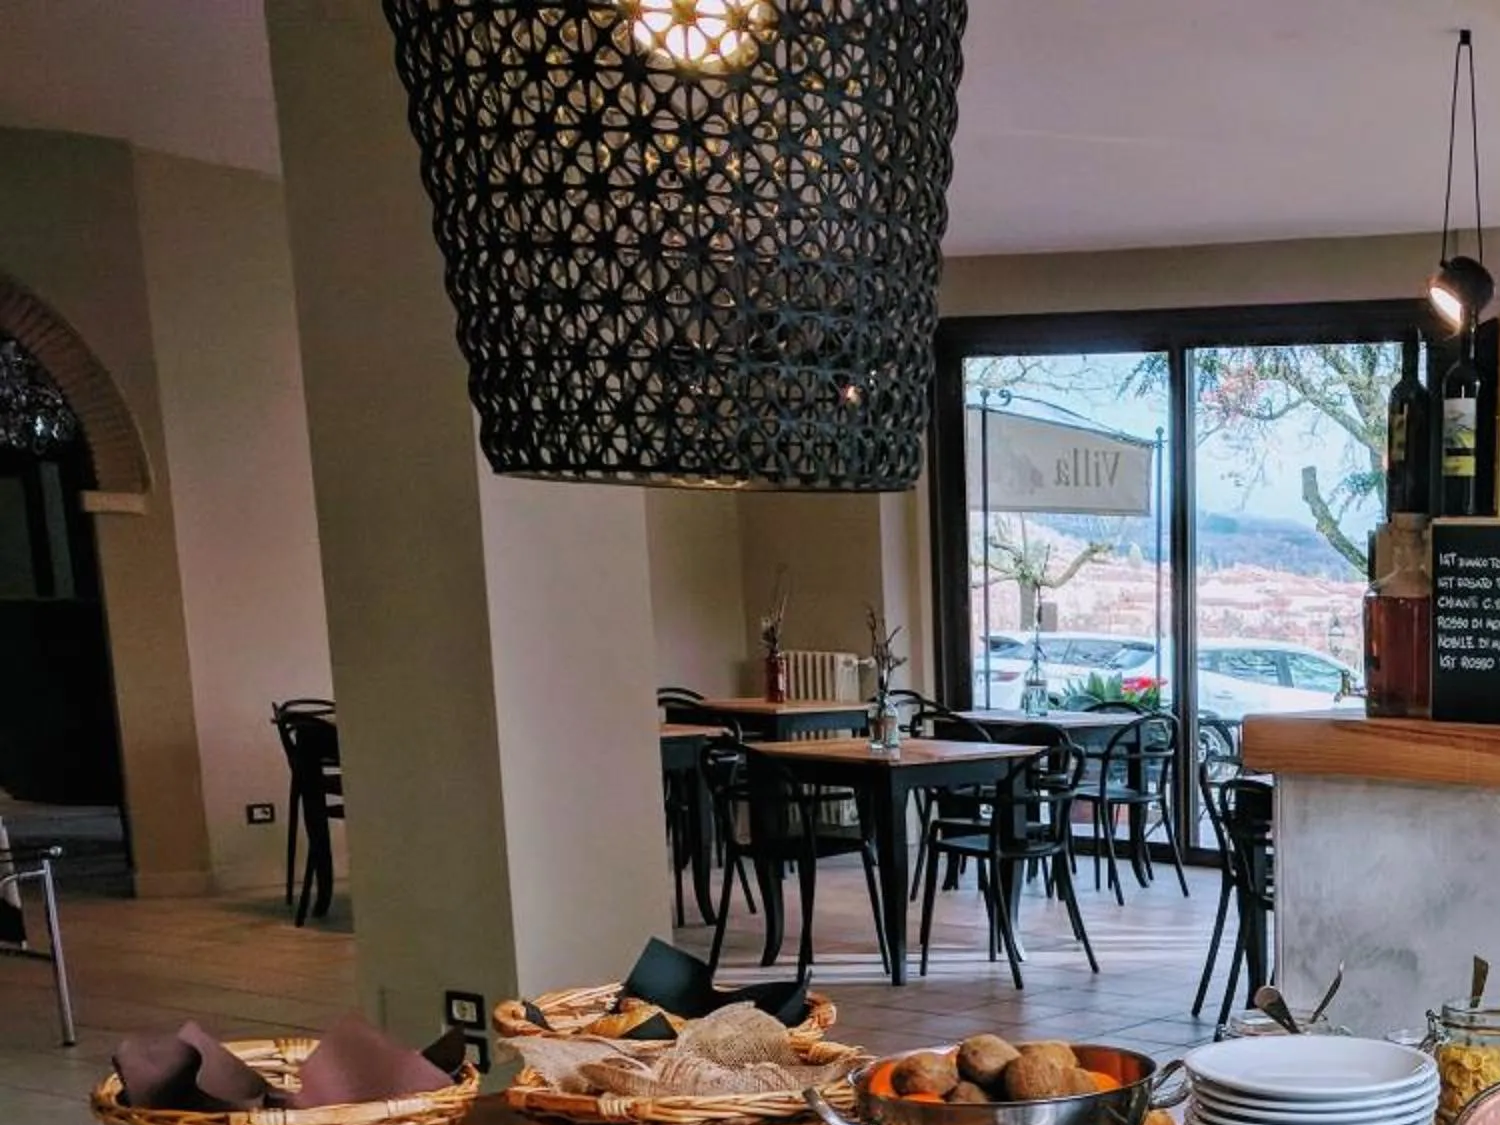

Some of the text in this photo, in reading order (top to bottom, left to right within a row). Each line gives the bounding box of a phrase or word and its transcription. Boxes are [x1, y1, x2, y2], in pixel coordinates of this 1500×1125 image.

[1437, 596, 1478, 609] CHIANTI
[1437, 616, 1469, 629] ROSSO
[1472, 618, 1484, 630] DI
[1437, 635, 1475, 650] NOBILE
[1479, 637, 1489, 650] DI
[1461, 656, 1494, 670] ROSSO
